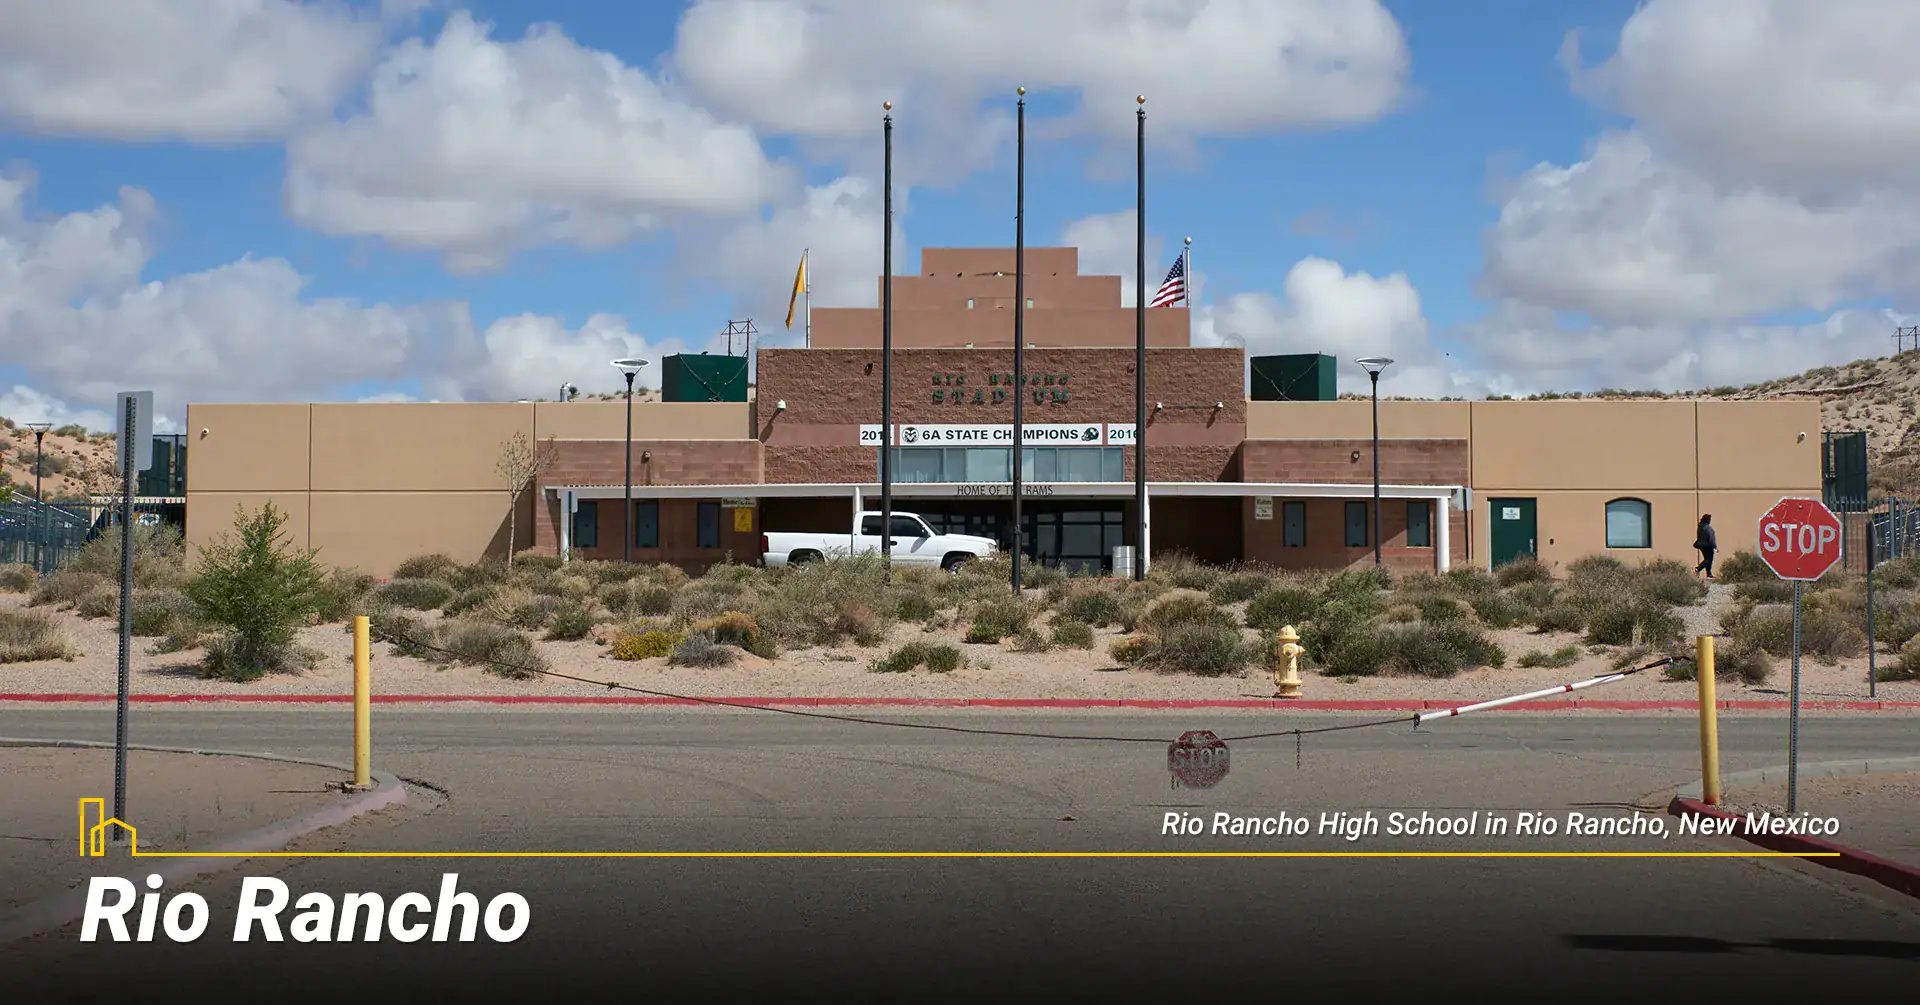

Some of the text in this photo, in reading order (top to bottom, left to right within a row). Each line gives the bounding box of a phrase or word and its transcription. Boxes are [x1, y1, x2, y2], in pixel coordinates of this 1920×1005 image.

[932, 388, 1069, 406] STADUM
[861, 430, 892, 441] 201
[922, 429, 1079, 440] 6A STATE CHMPIONS
[957, 485, 986, 495] HOME
[988, 485, 1001, 495] OF
[1026, 485, 1053, 495] RAMS
[1763, 522, 1836, 555] STOP
[1173, 747, 1228, 770] STOP
